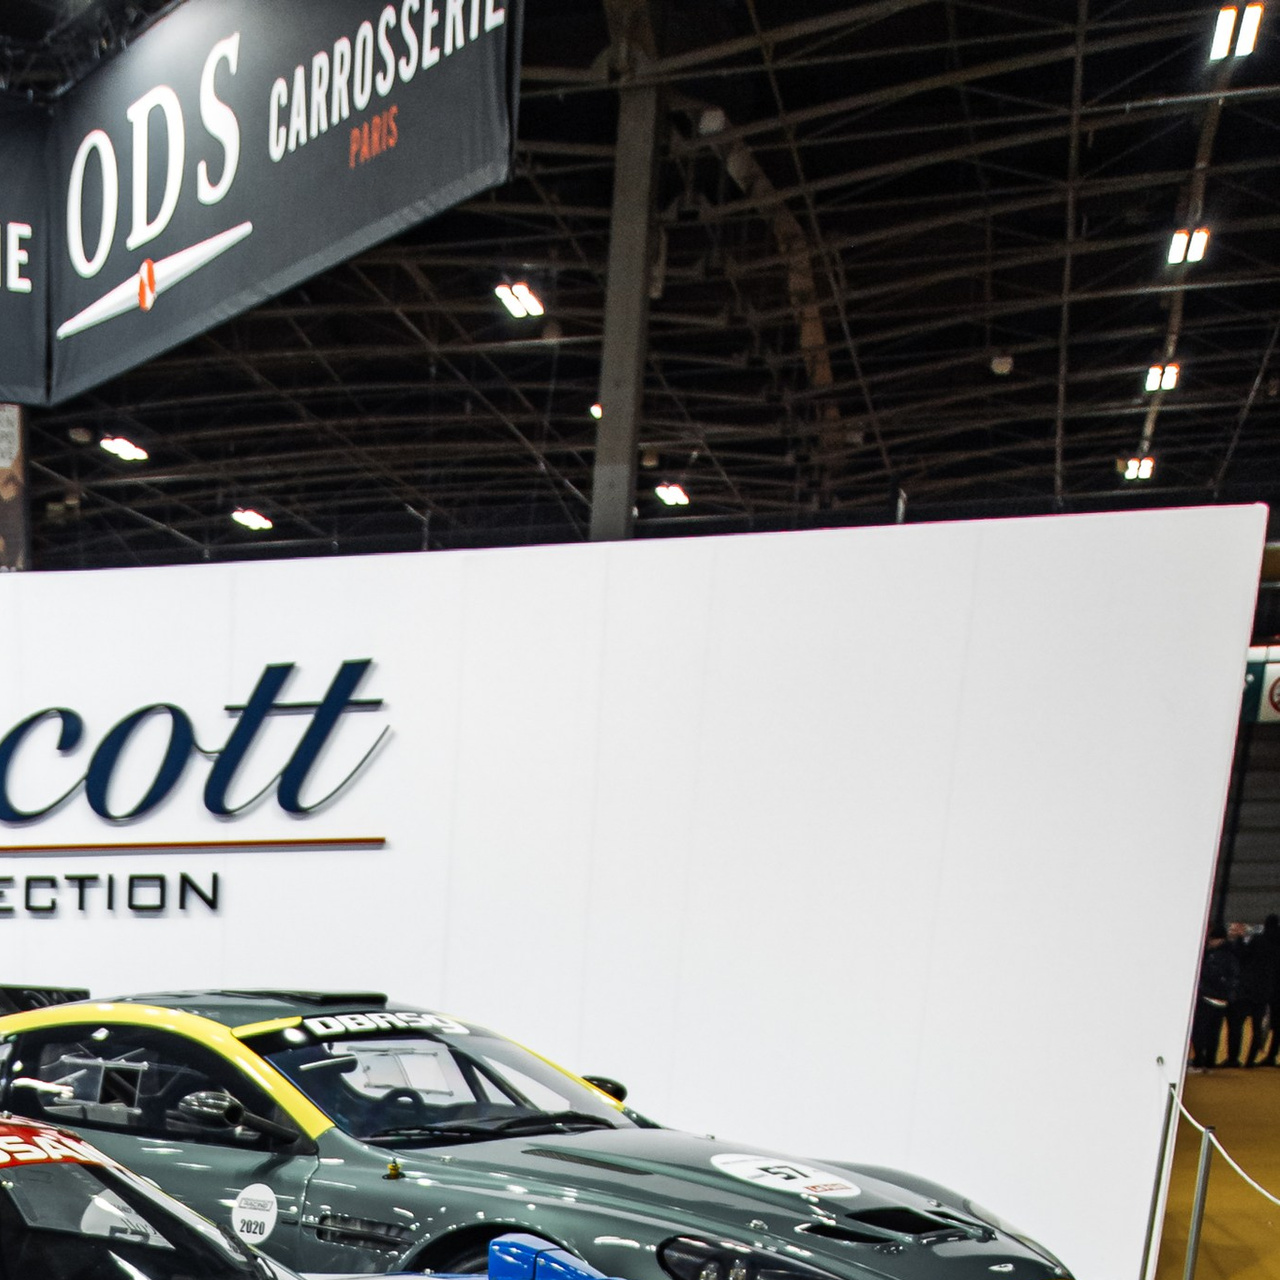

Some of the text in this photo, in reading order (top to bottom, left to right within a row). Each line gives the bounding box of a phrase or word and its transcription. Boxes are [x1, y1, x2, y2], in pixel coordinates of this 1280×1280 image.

[67, 32, 241, 278] ODS
[349, 105, 399, 169] PARIS
[239, 1218, 266, 1236] 2020
